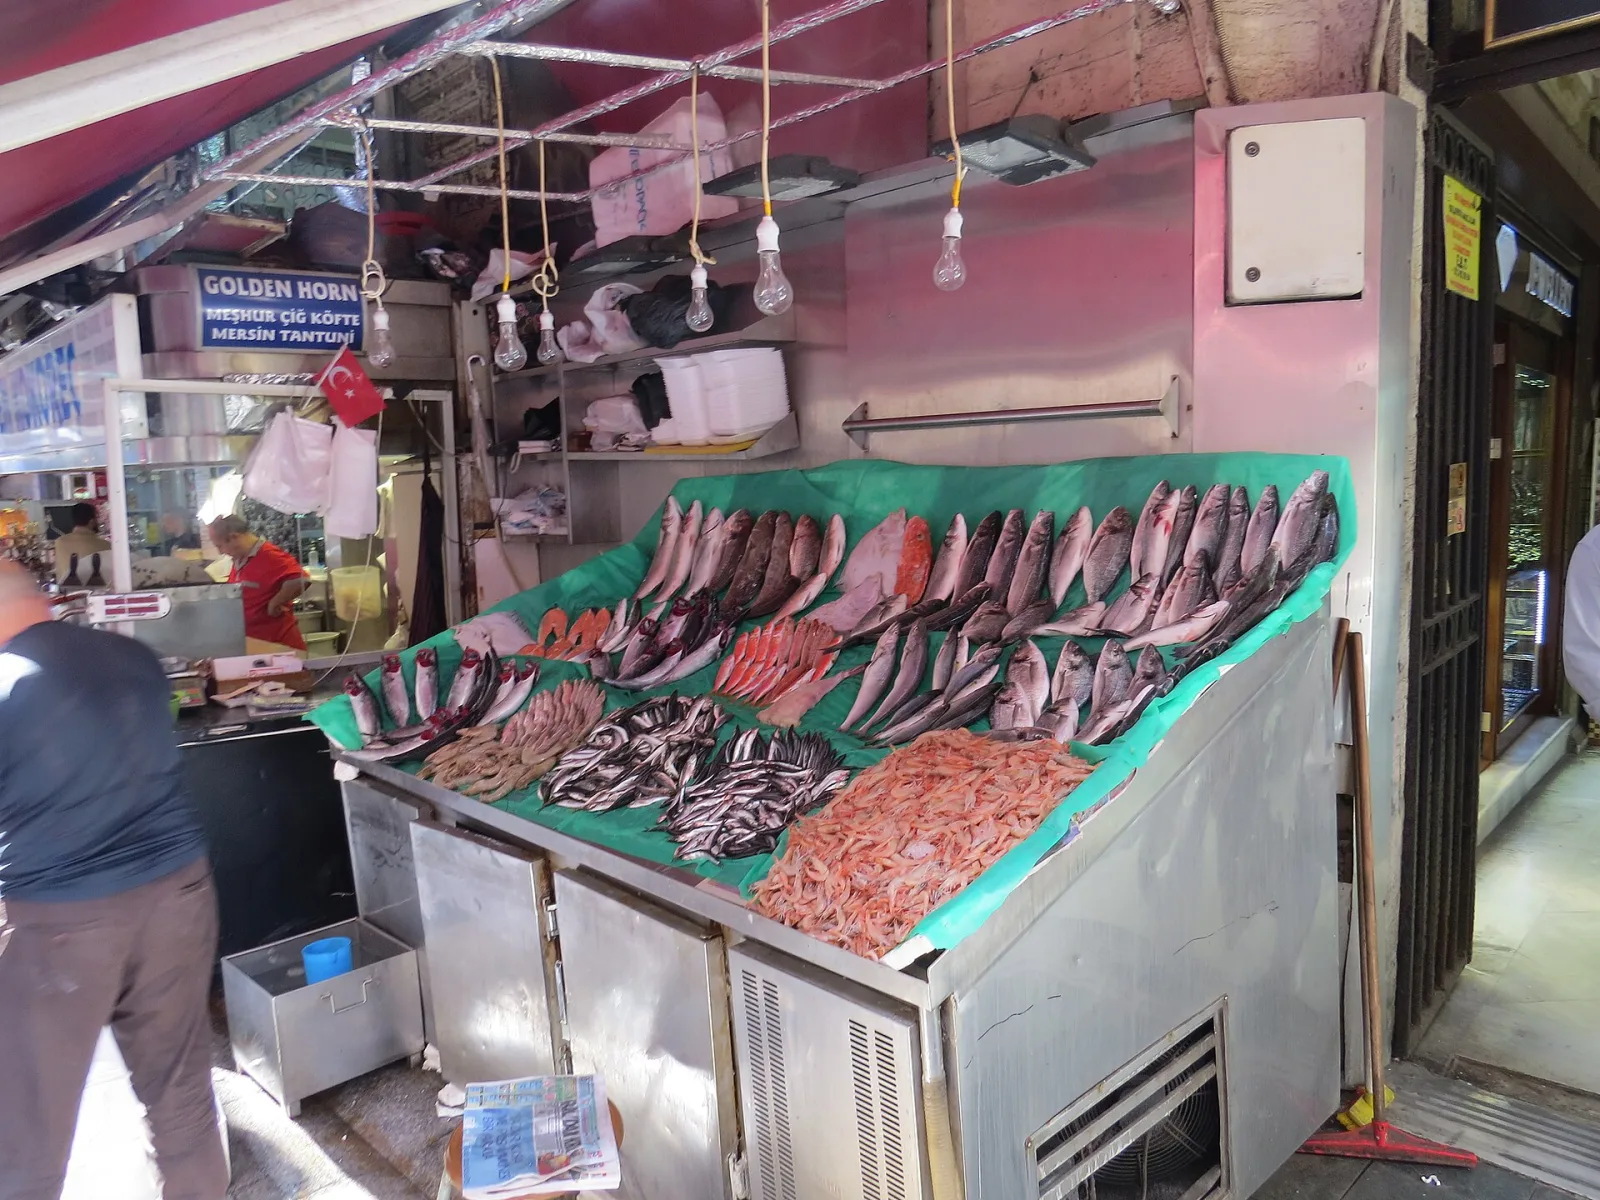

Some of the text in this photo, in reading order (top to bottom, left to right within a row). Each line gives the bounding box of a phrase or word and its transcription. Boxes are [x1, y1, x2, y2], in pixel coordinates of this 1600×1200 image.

[203, 275, 359, 302] GOLDEN HORN
[206, 308, 361, 327] MEŞHUR ÇİĞ KÖFTE
[211, 326, 355, 344] MERSİN TANTUNİ
